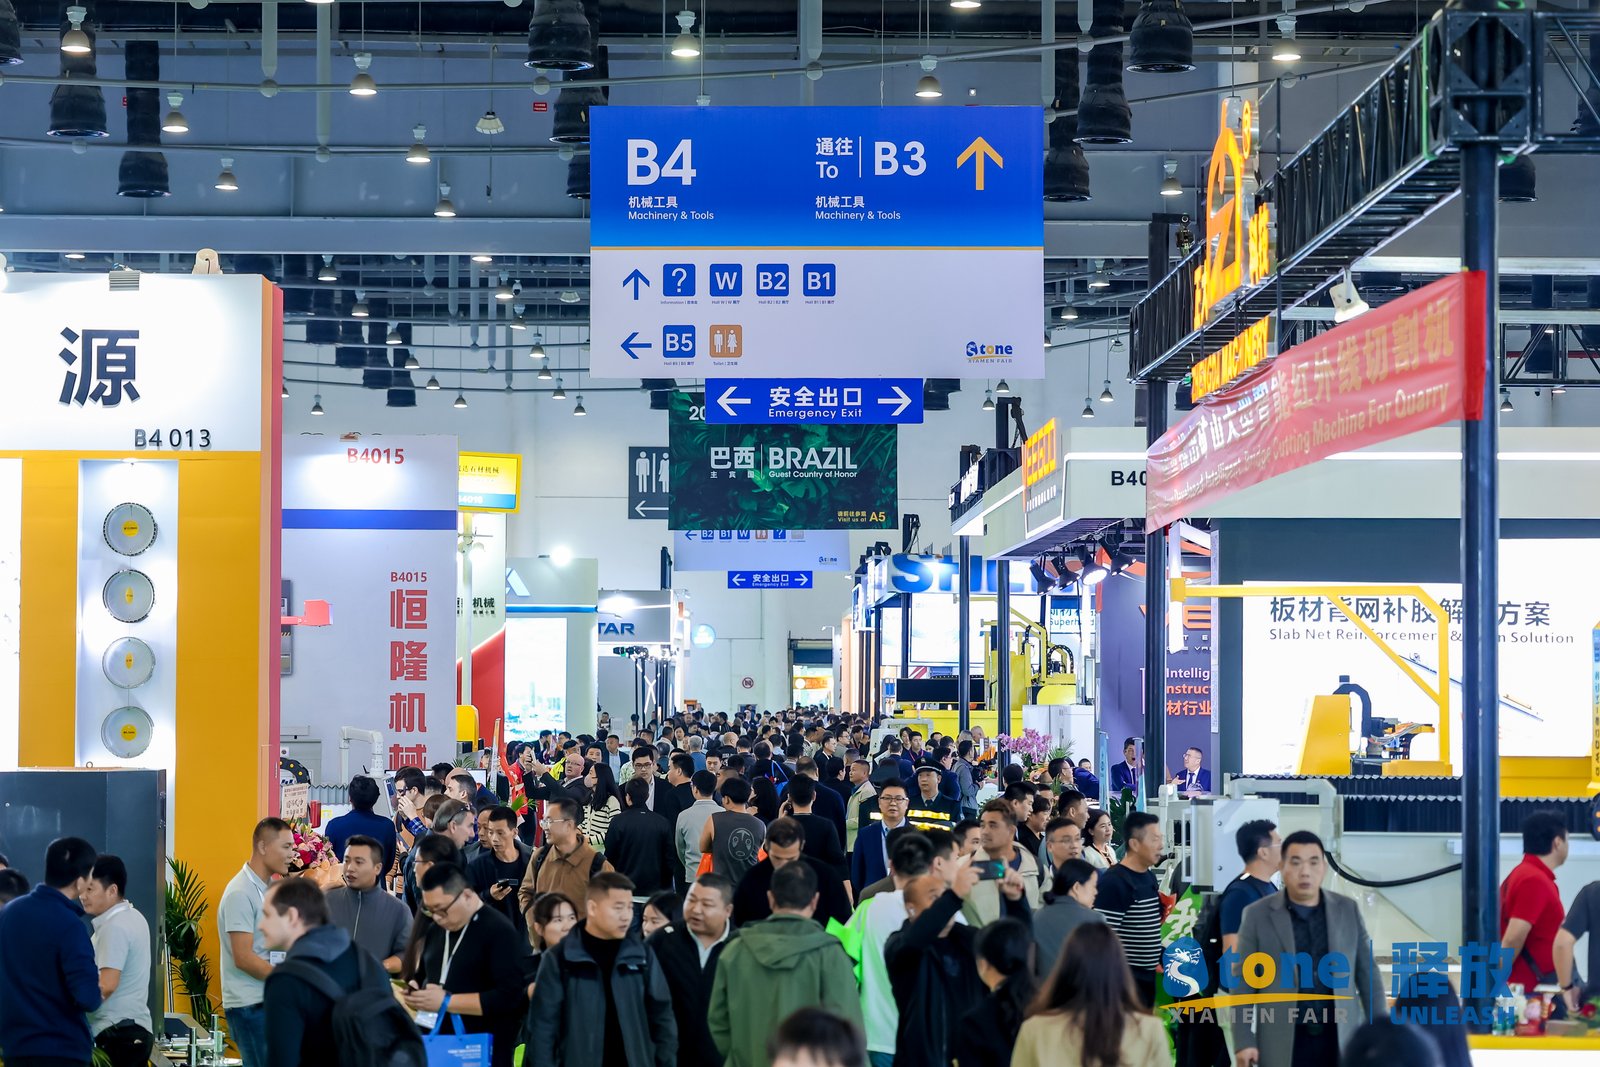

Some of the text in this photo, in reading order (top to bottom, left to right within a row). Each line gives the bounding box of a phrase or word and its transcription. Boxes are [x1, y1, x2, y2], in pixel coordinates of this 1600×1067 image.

[815, 137, 853, 157] 通往
[627, 139, 696, 186] B4
[874, 141, 926, 177] B3
[816, 162, 839, 179] To
[628, 196, 678, 208] 机械工具
[815, 196, 865, 208] 机械工具
[628, 210, 714, 221] Machinery & Tools
[815, 210, 901, 221] Machinery & Tools
[715, 272, 737, 290] W
[759, 272, 787, 290] B2
[808, 272, 831, 290] B1
[665, 333, 693, 351] B5
[966, 341, 1013, 357] Stone
[59, 327, 141, 407] 源
[769, 386, 862, 407] 安全出口
[768, 408, 862, 419] Emergency Exit
[1313, 408, 1365, 445] Machine
[1369, 398, 1392, 428] For
[1395, 382, 1449, 418] Quarry
[347, 448, 405, 465] B4015
[710, 446, 755, 469] 巴西
[769, 446, 858, 469] BRAZIL
[769, 470, 858, 479] Guest Country of Honor
[869, 512, 886, 522] A5
[720, 529, 731, 538] B1
[390, 572, 428, 583] B4015
[752, 573, 789, 583] 安全出口
[1270, 596, 1550, 626] 板材背网补胶解方案
[1270, 628, 1301, 640] Slab
[1306, 629, 1331, 640] Net
[1511, 632, 1574, 643] Solution
[388, 588, 428, 770] 恒隆机械
[1167, 684, 1211, 694] nstruc
[1167, 700, 1211, 716] 材行业
